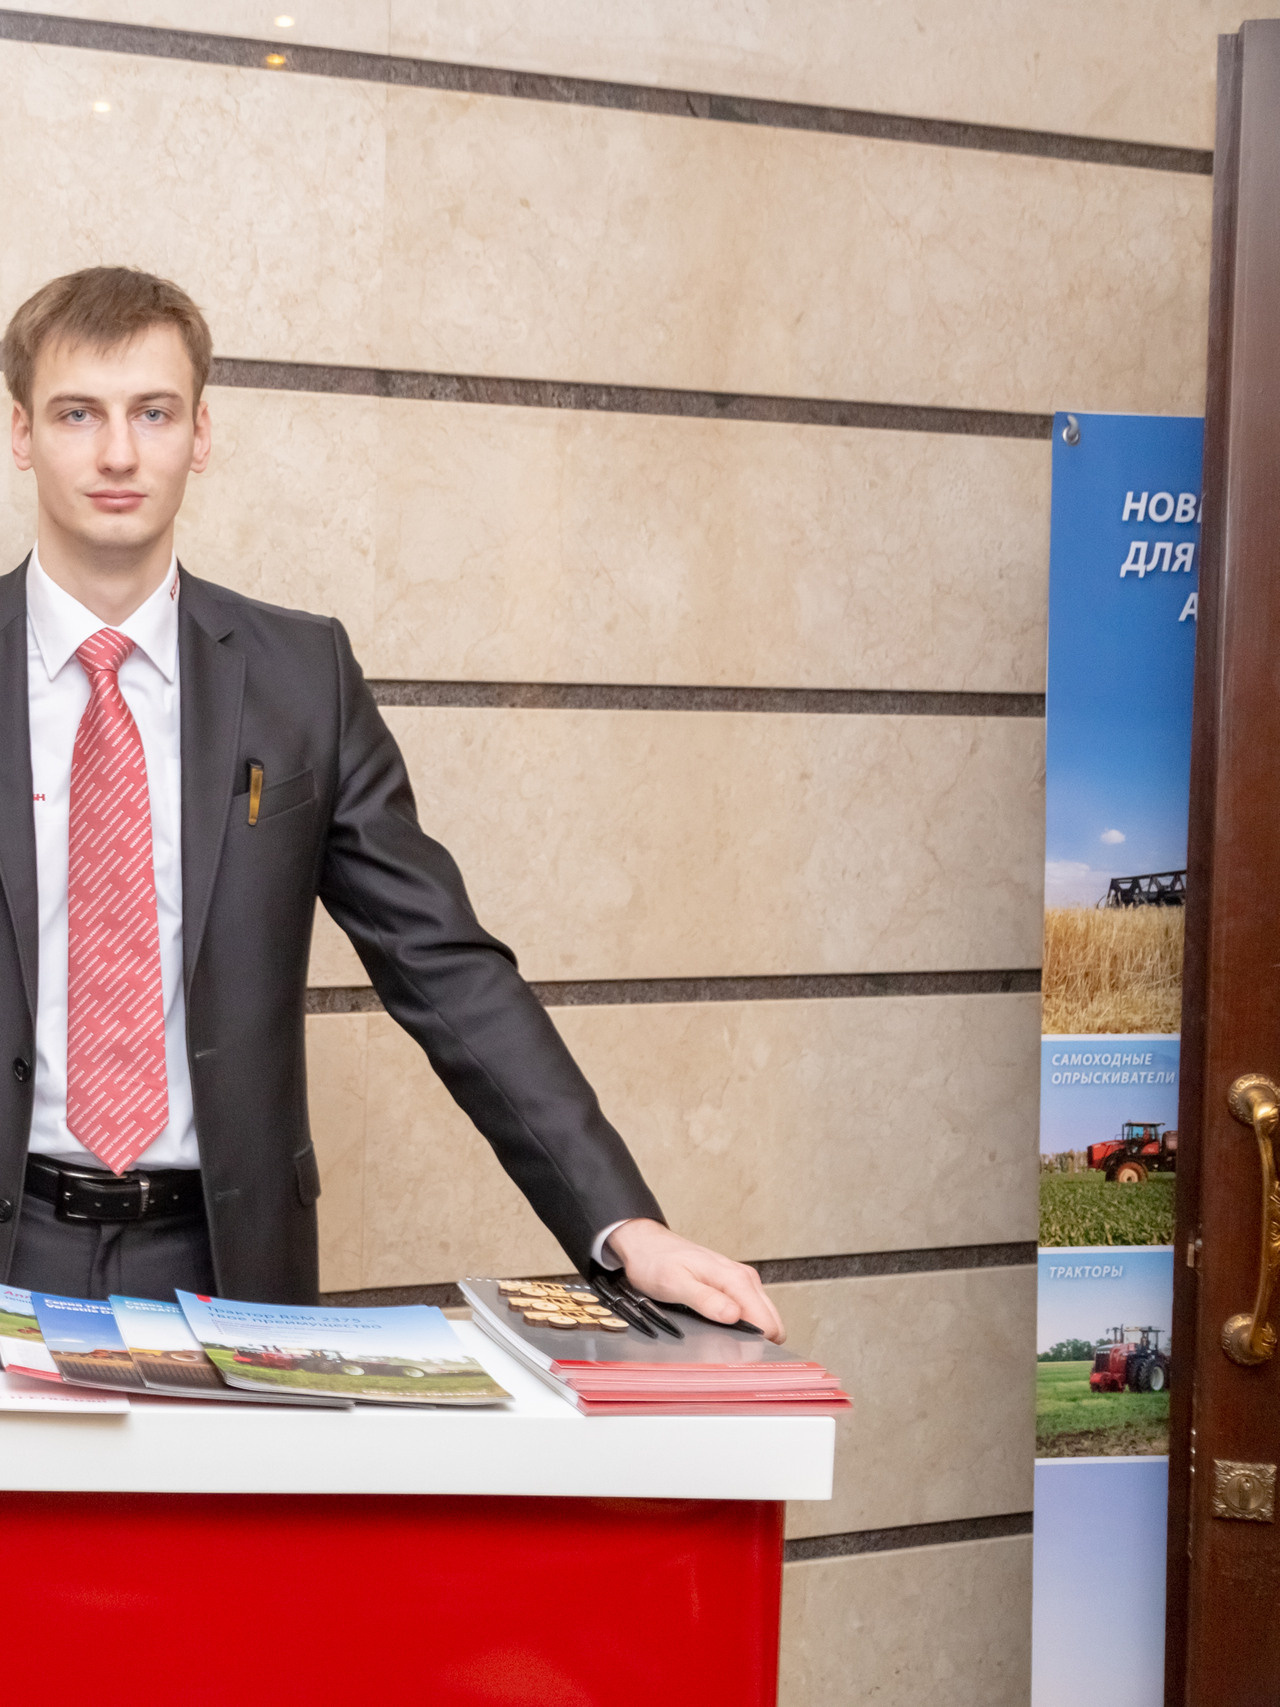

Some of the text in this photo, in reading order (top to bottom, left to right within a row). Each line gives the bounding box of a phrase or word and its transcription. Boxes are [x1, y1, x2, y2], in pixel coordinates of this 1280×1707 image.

[1122, 491, 1202, 523] НОВ
[1120, 541, 1195, 578] ДЛЯ
[1051, 1053, 1153, 1068] САМОХОДНЫЕ
[1051, 1071, 1176, 1085] ОПРЫСКИВАТЕЛИ
[1049, 1265, 1124, 1279] ТРАКТОРЫ
[252, 1317, 383, 1330] преимущество
